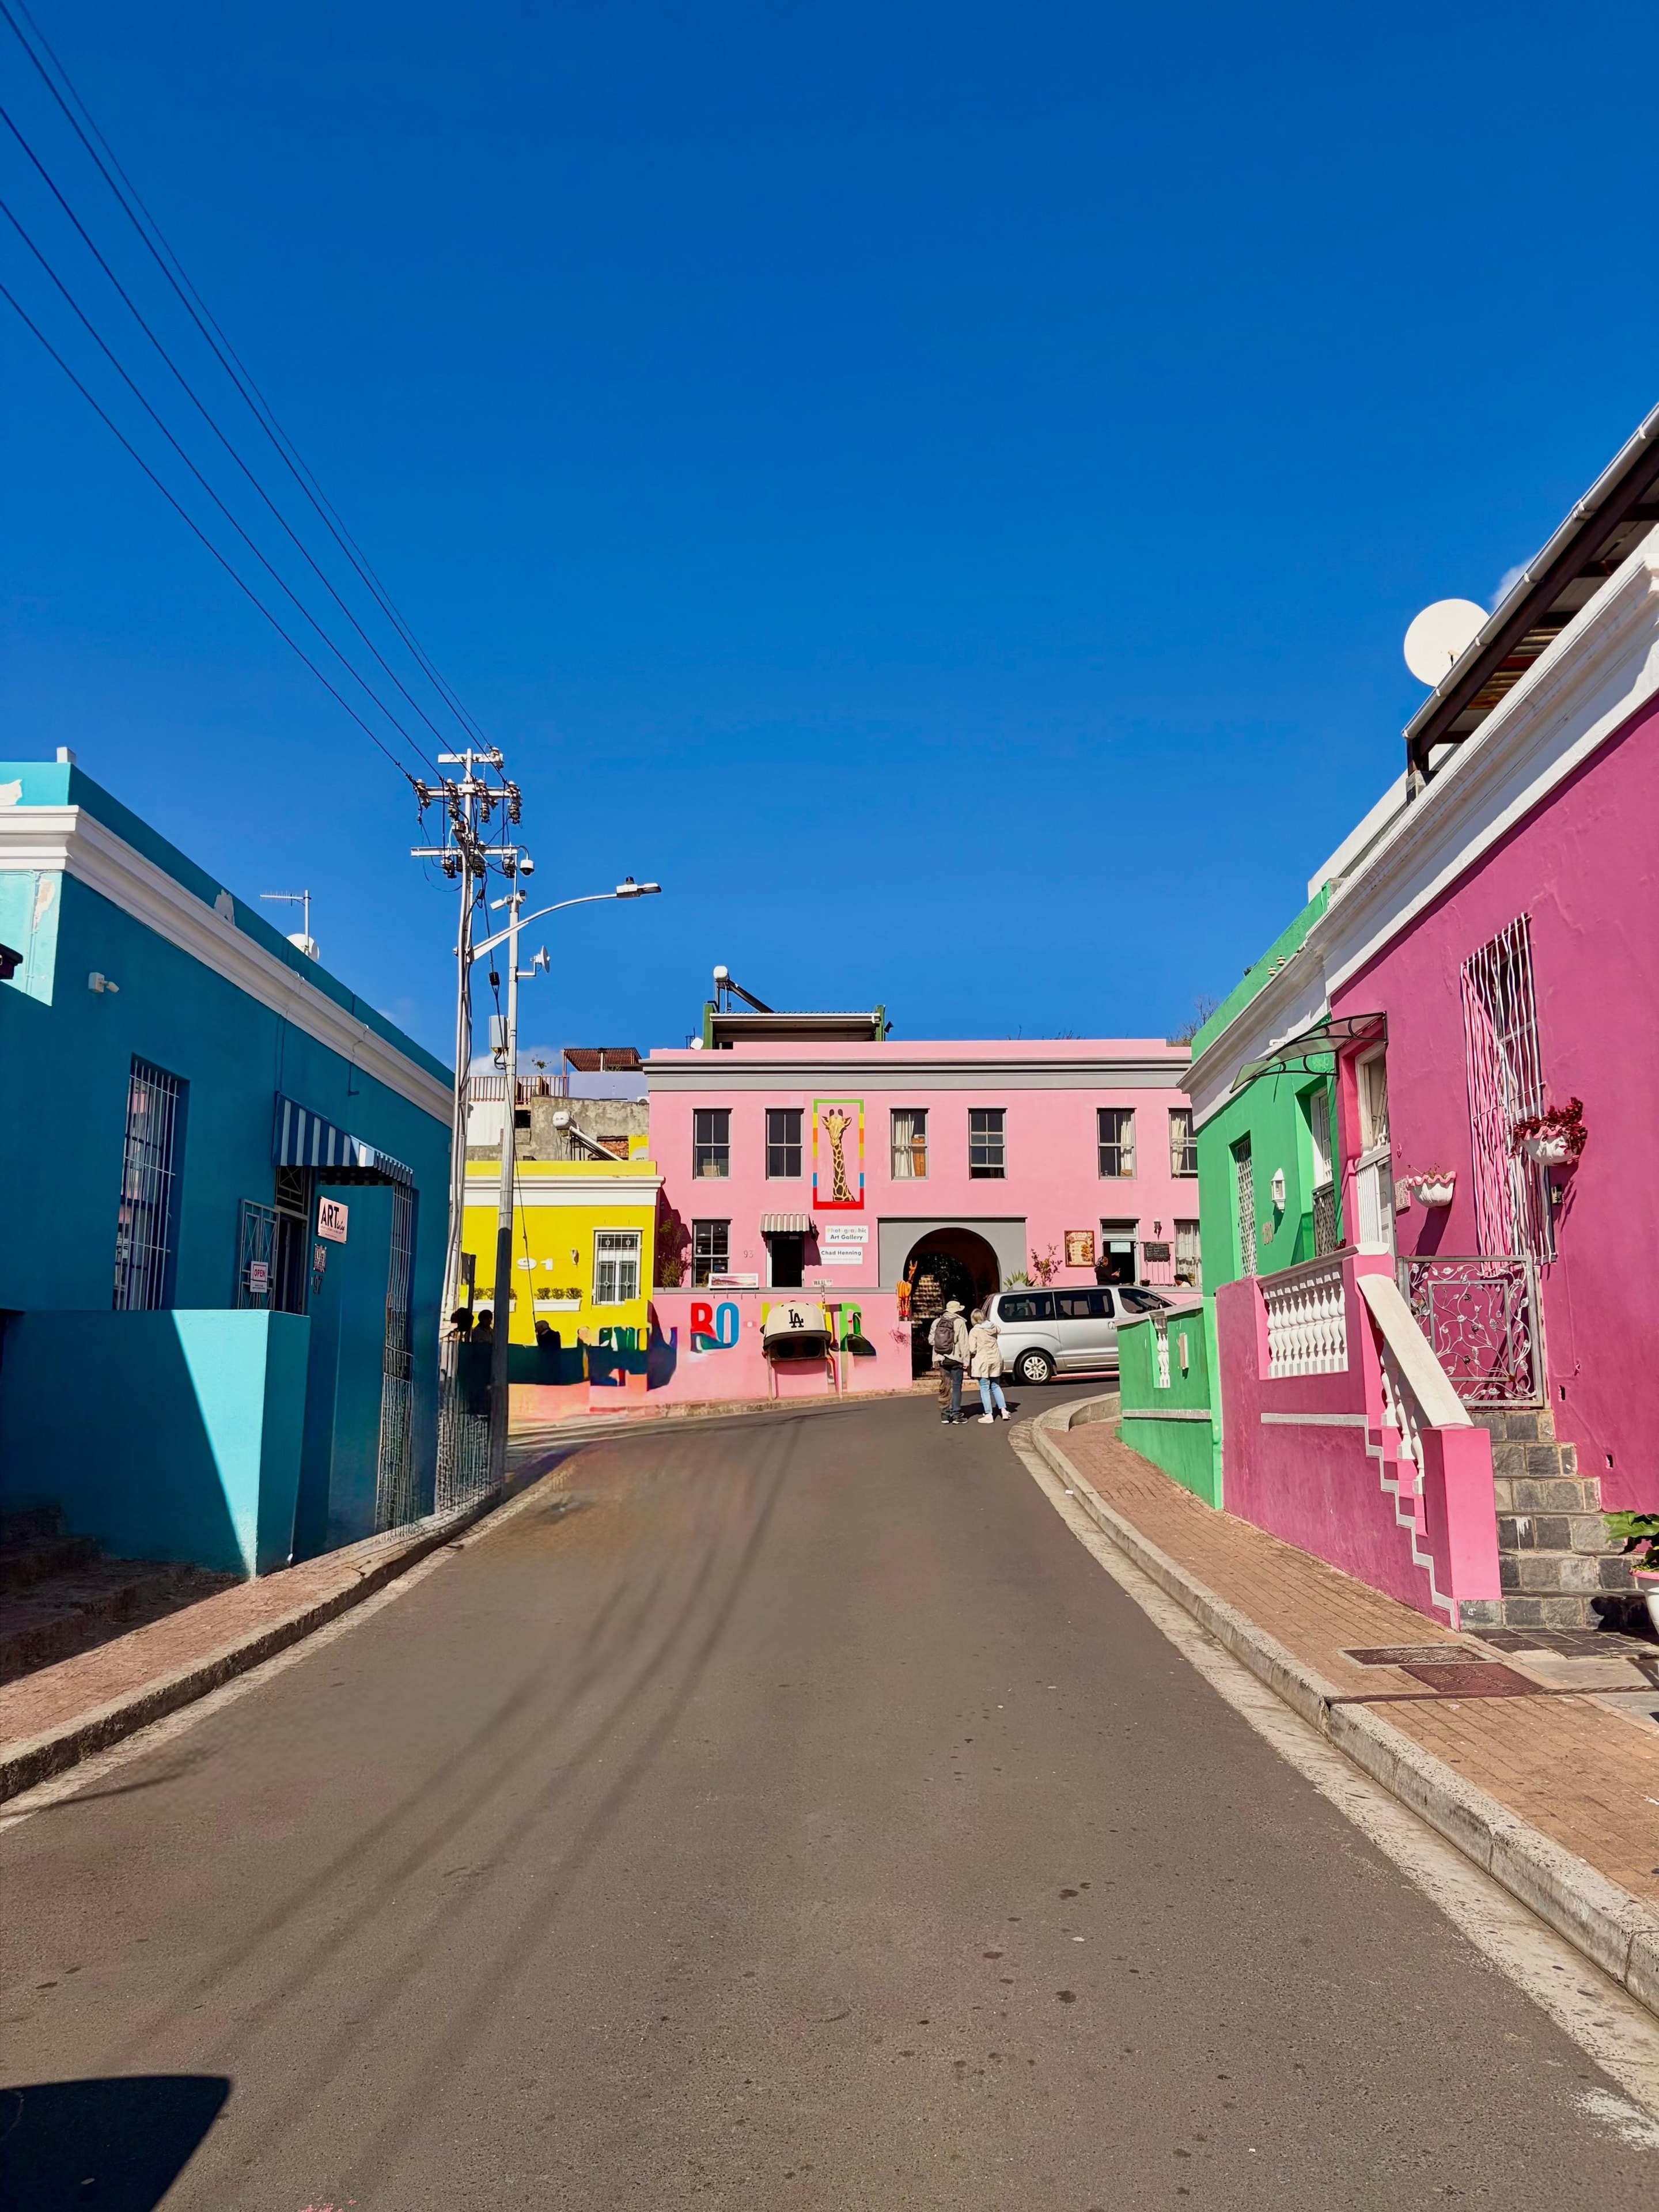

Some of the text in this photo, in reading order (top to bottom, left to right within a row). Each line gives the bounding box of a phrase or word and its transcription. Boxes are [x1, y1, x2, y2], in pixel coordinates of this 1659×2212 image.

[321, 1203, 339, 1229] ART
[743, 1250, 754, 1258] 93
[254, 1269, 265, 1277] OPEN
[789, 1309, 804, 1328] LA
